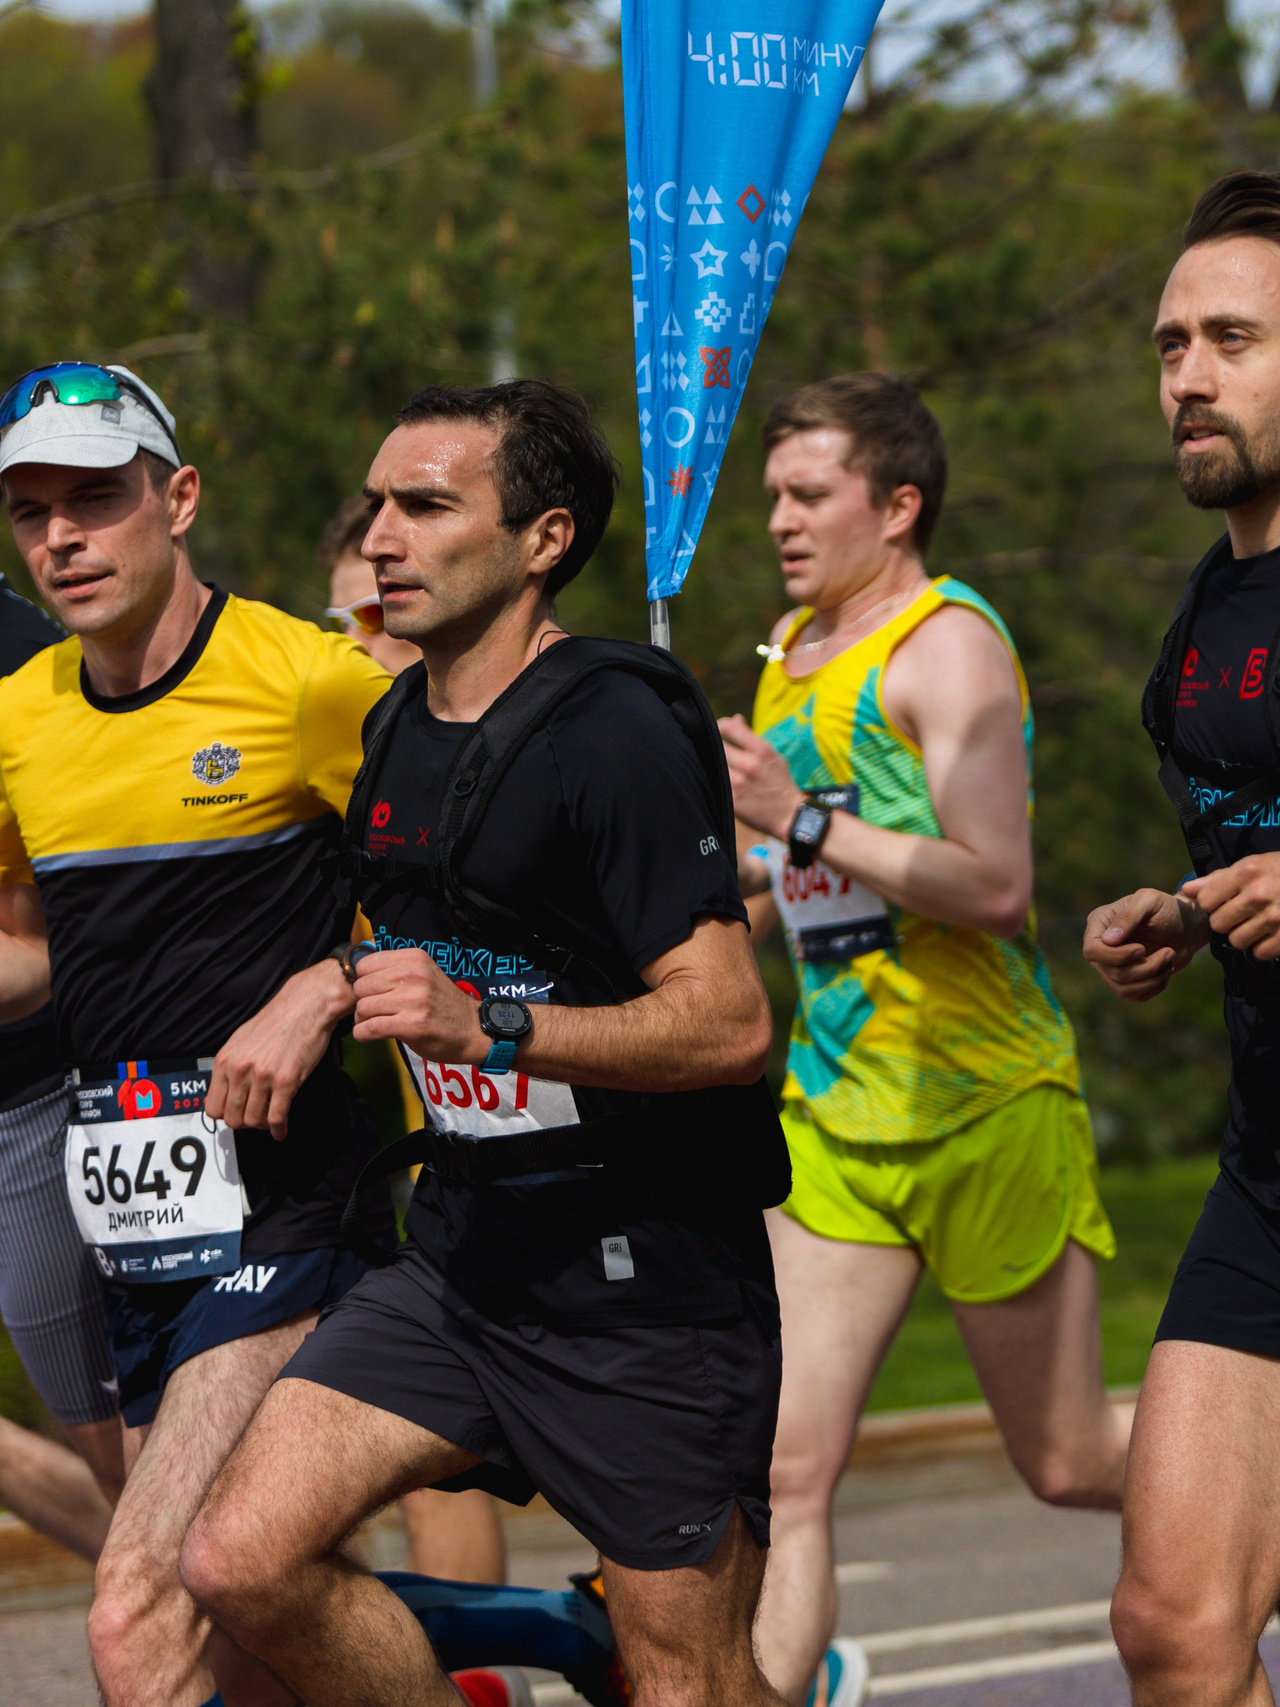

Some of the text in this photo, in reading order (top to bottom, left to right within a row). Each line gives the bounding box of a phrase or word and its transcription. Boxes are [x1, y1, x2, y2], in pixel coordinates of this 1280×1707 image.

[687, 30, 787, 89] 4:00
[793, 69, 820, 97] КМ
[181, 793, 249, 807] TINKOFF
[174, 1097, 207, 1110] 202
[82, 1135, 207, 1205] 5649
[108, 1203, 184, 1232] ДМИТРИЙ
[678, 1524, 701, 1534] RUN
